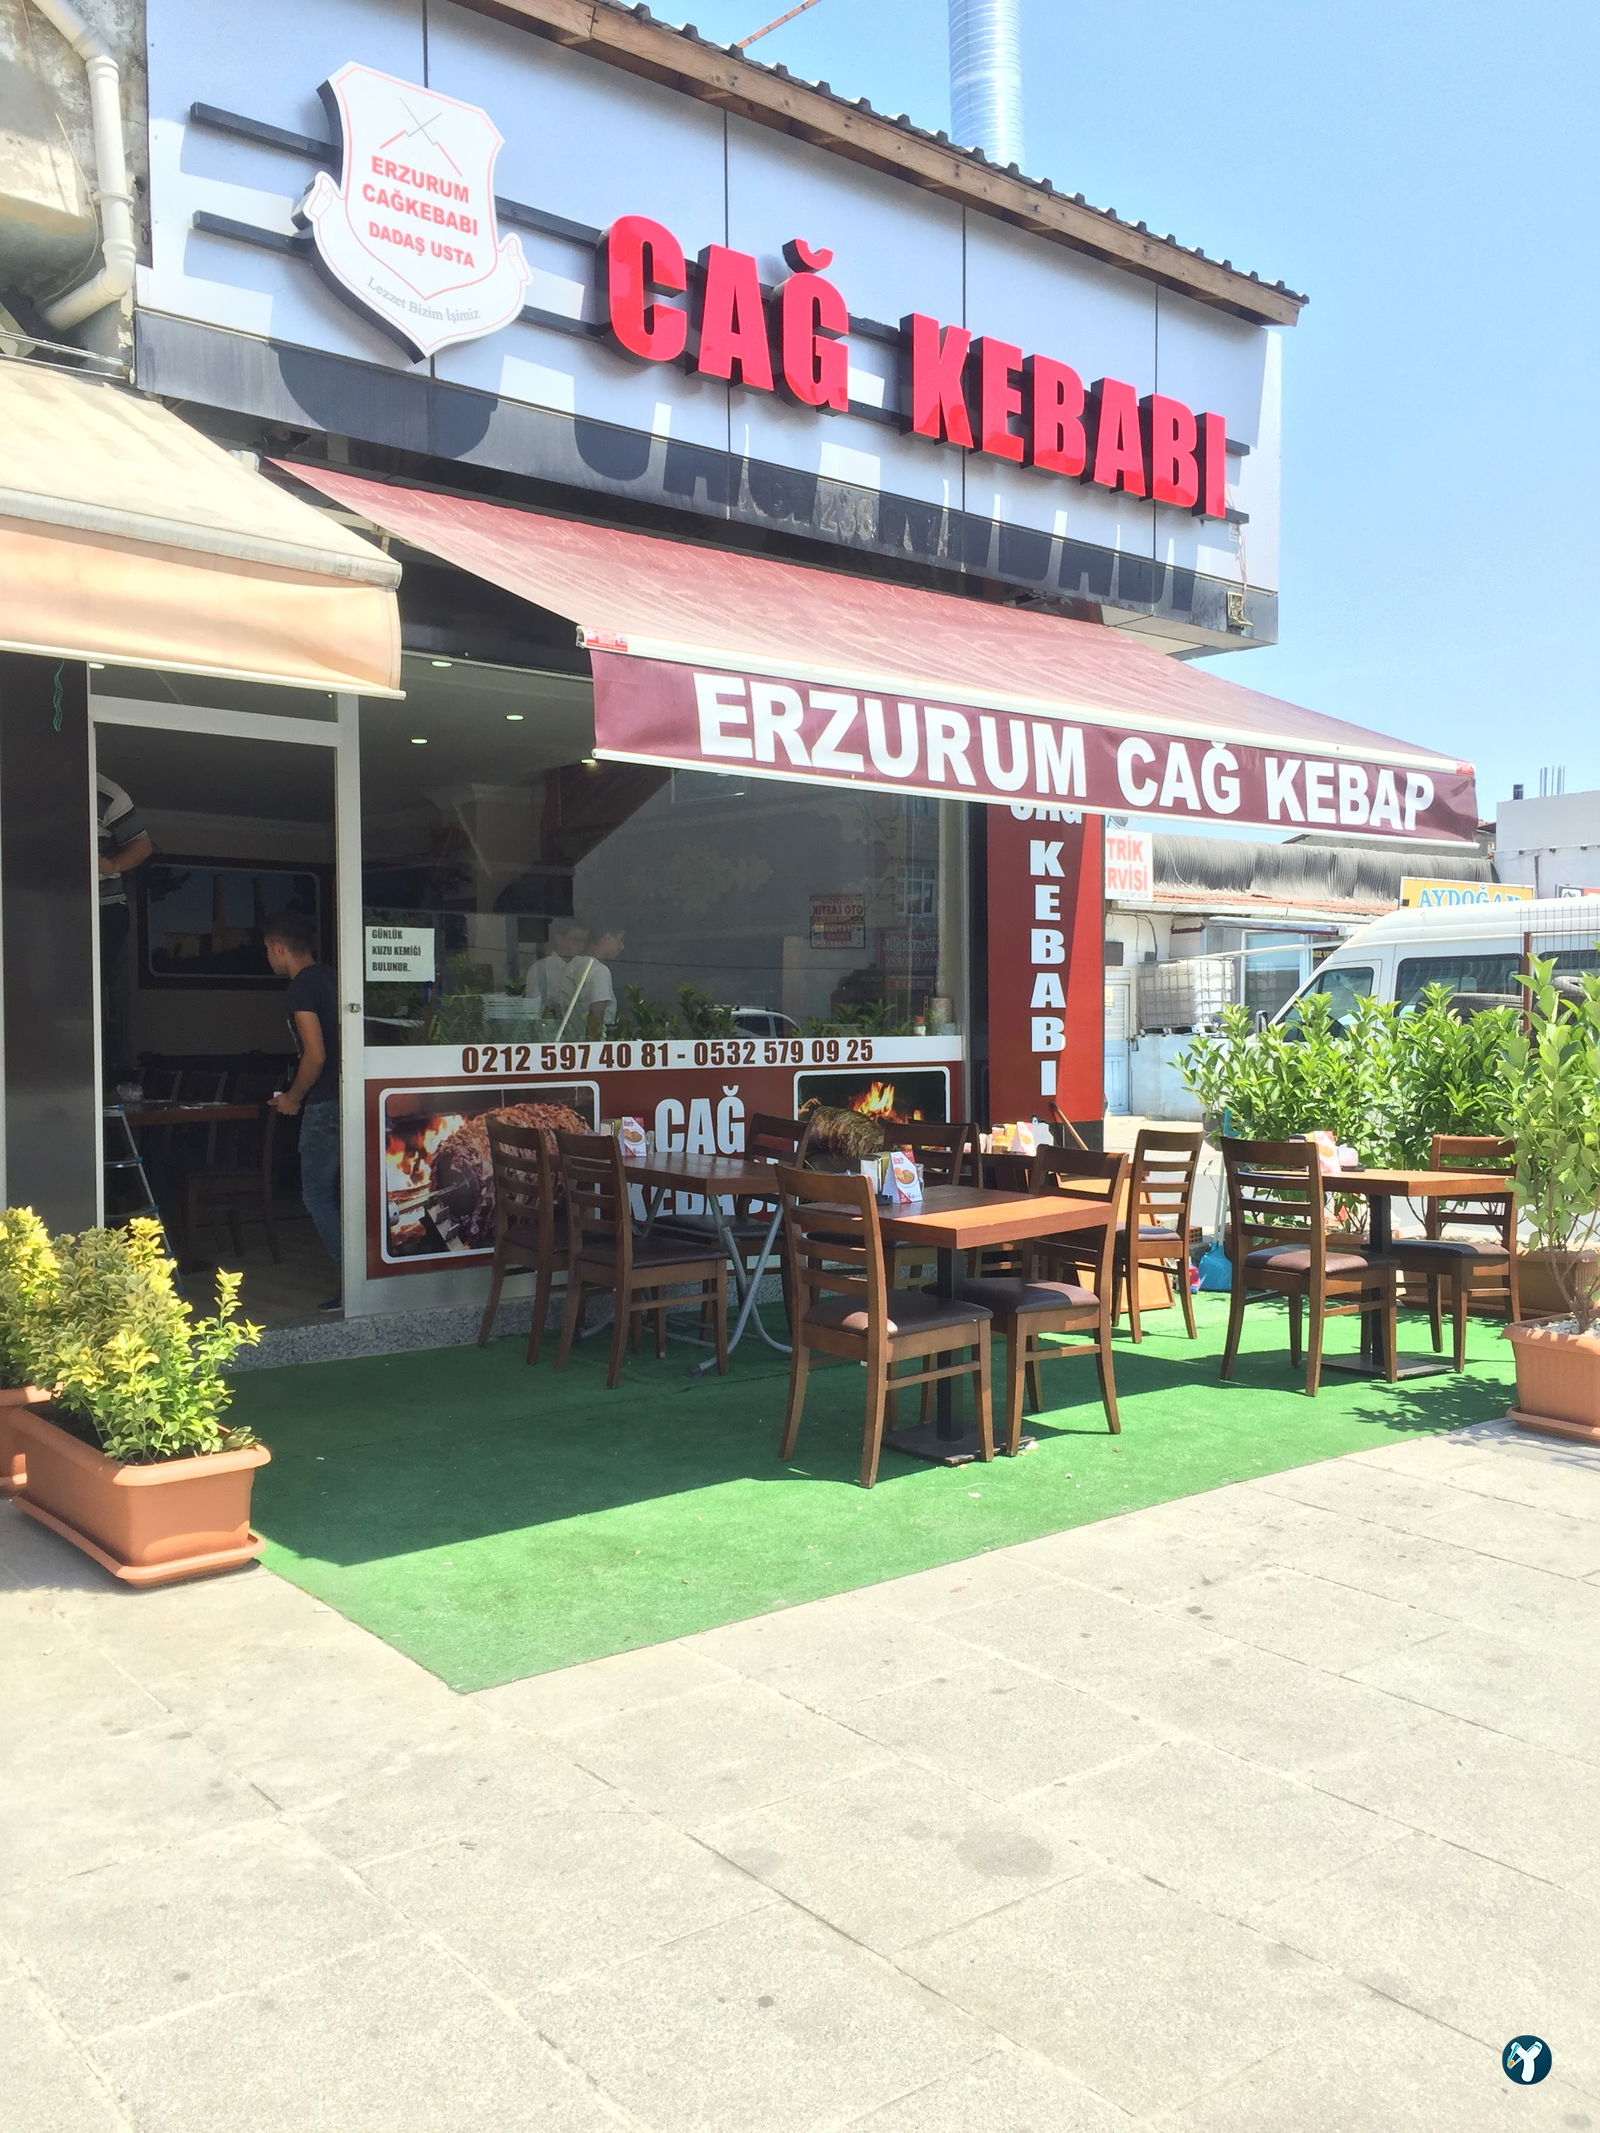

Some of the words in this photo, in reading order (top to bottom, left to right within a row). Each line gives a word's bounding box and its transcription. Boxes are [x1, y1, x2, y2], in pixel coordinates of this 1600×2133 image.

[371, 155, 469, 204] ERZURUM
[362, 184, 478, 236] CAĞKEBABI
[368, 221, 426, 257] DADAŞ
[430, 241, 475, 268] USTA
[367, 276, 406, 308] Lezzet
[408, 301, 444, 321] Bizim
[604, 214, 849, 413] CAĞ
[908, 312, 1227, 519] KEBABI
[692, 672, 1088, 798] ERZURUM
[1116, 737, 1241, 815] CAĞ
[1264, 756, 1435, 831] KEBAP
[371, 945, 392, 956] KUZU
[393, 945, 421, 956] KEMİĞİ
[372, 929, 403, 940] GÜNLÜK
[1029, 838, 1067, 1097] KEBABI
[462, 1046, 531, 1074] 0212
[540, 1044, 591, 1071] 597
[599, 1043, 632, 1069] 40
[640, 1042, 669, 1068] 81
[693, 1040, 756, 1066] 0532
[763, 1040, 804, 1064] 579
[811, 1039, 840, 1063] 09
[846, 1039, 874, 1062] 25
[655, 1085, 746, 1155] CAĞ
